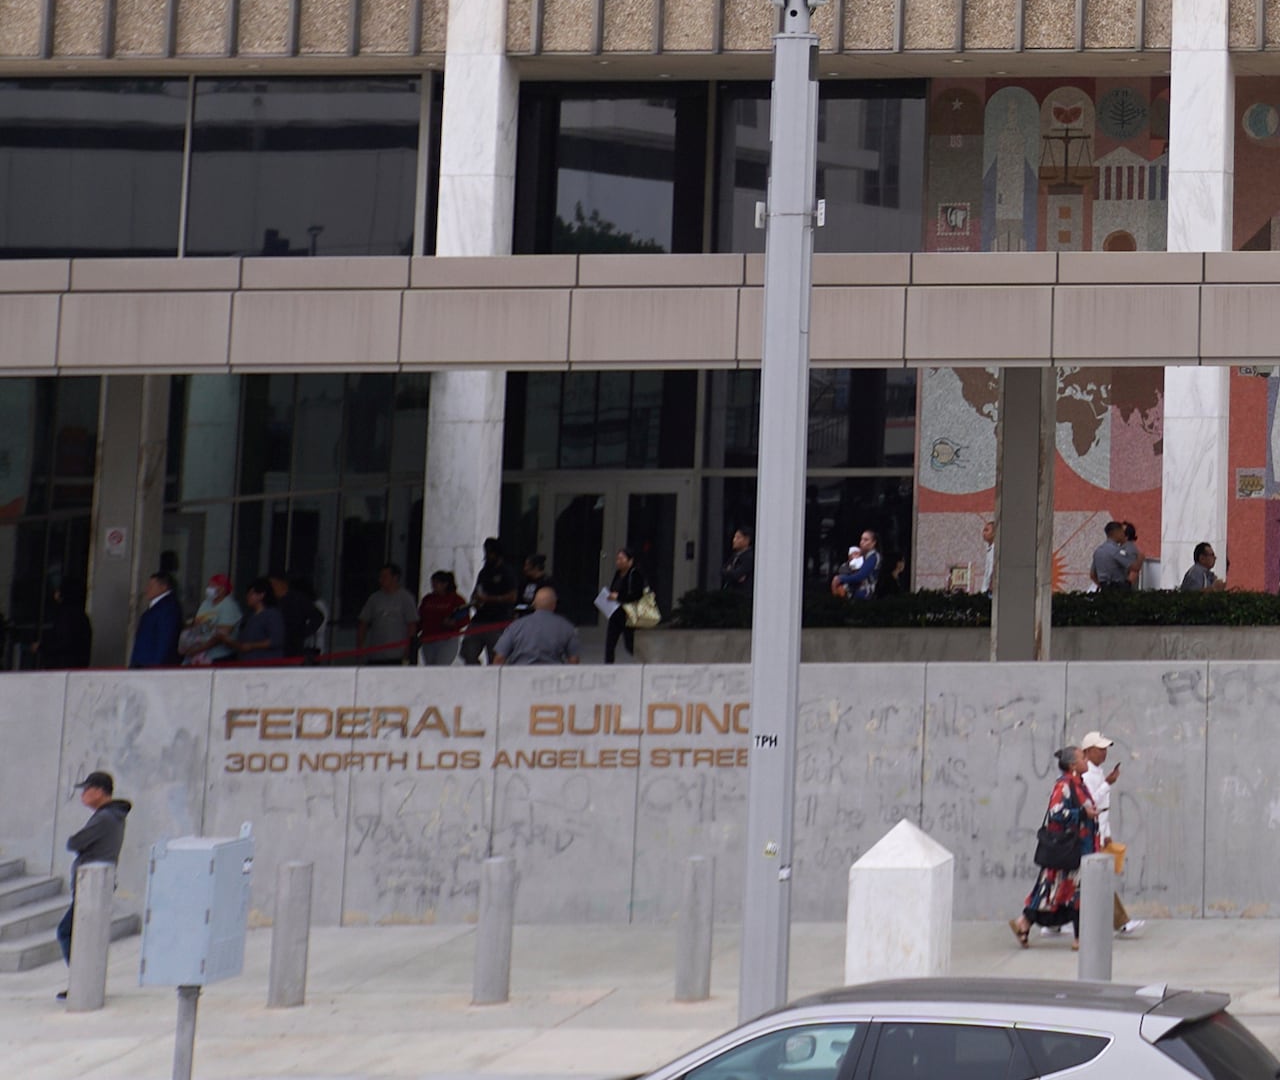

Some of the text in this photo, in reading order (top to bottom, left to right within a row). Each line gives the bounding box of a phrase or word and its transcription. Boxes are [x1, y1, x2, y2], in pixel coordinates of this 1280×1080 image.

[223, 705, 487, 741] FEDERAL
[223, 748, 749, 773] 300 NORTH LOS ANGELES STREE
